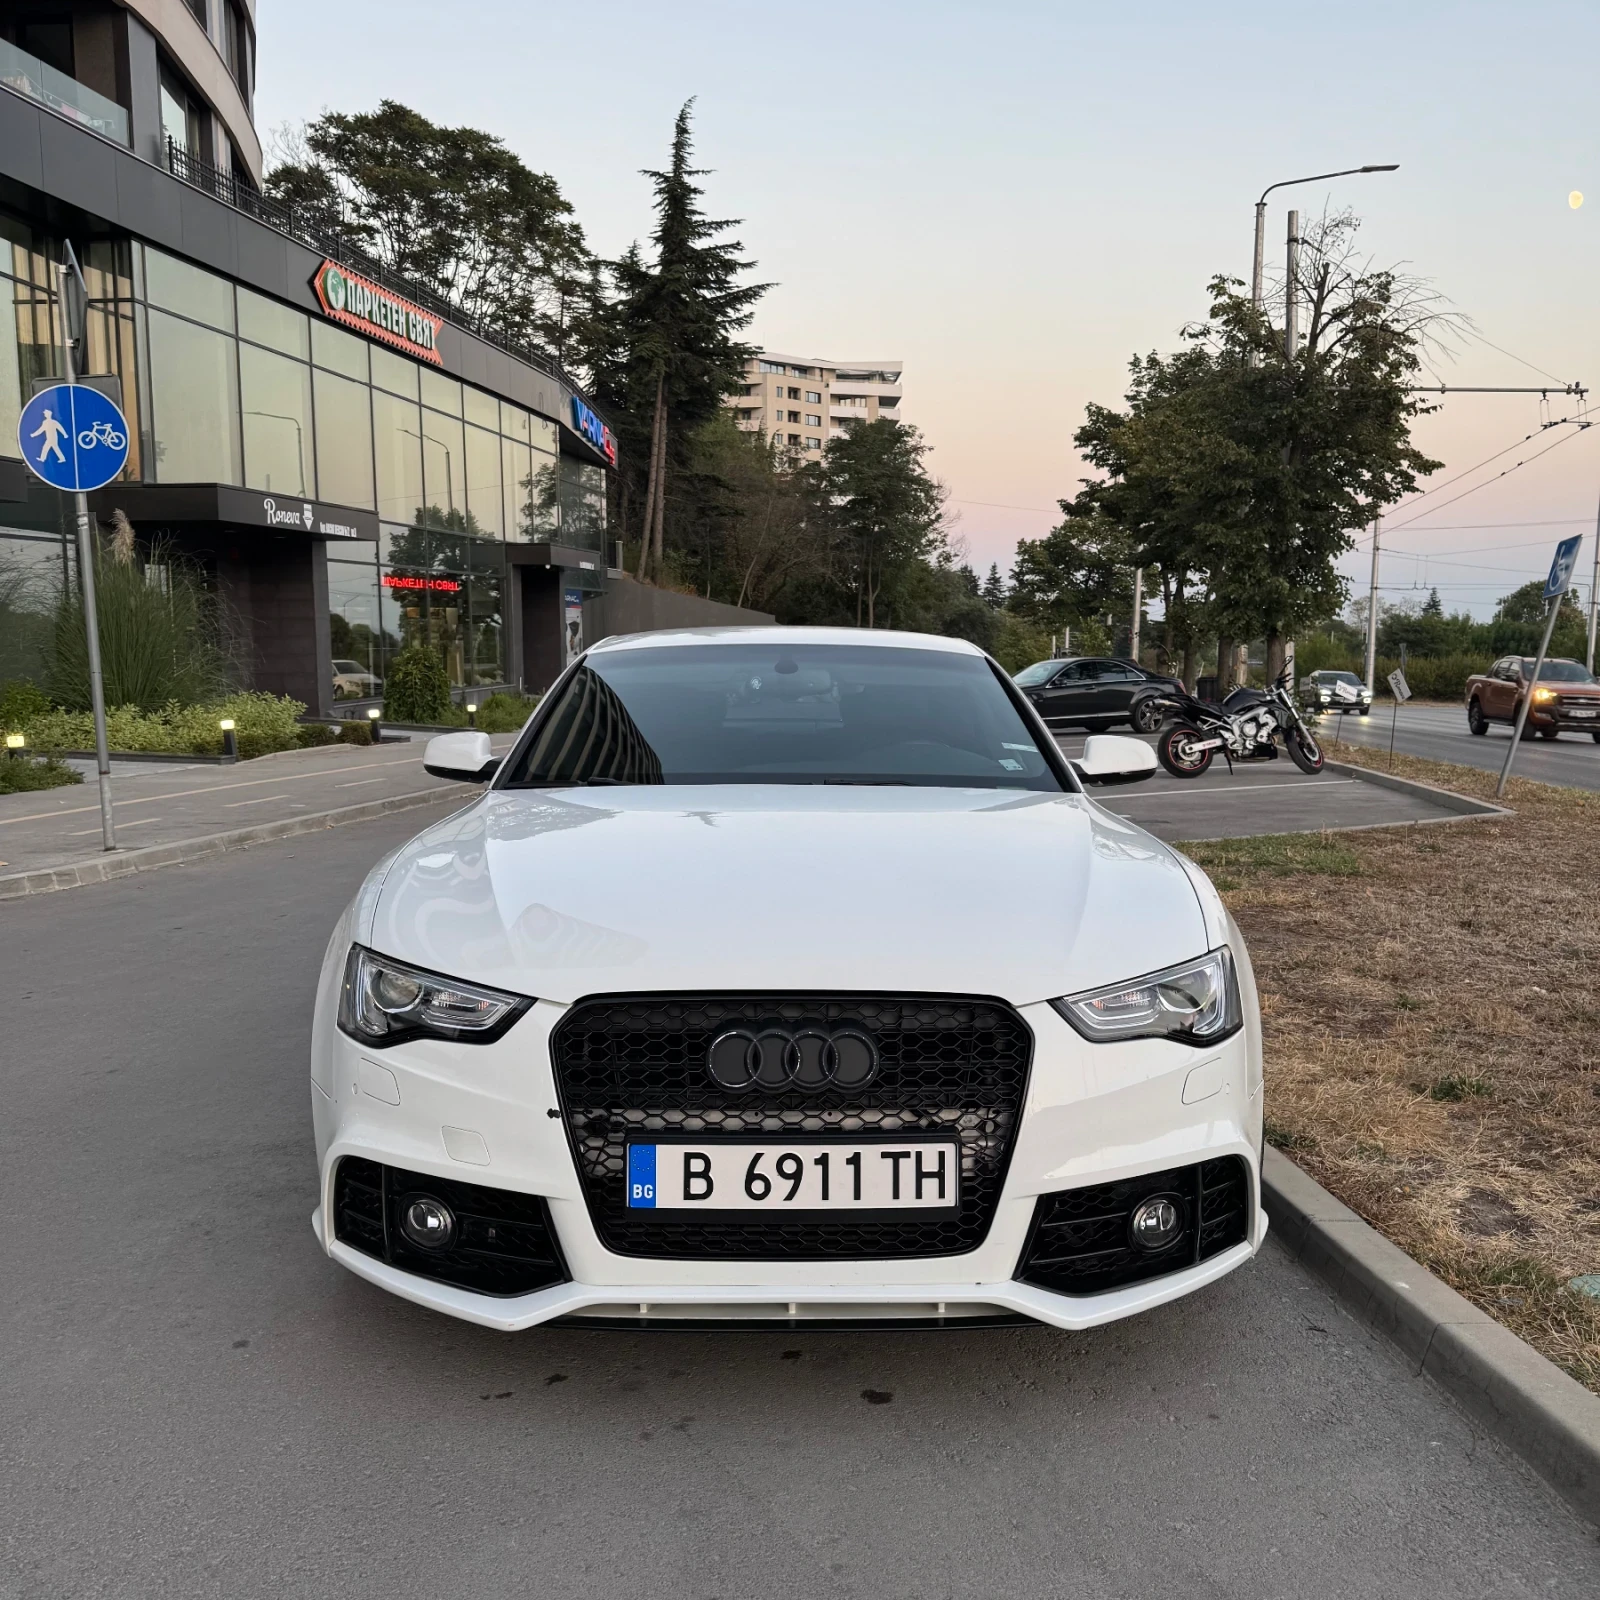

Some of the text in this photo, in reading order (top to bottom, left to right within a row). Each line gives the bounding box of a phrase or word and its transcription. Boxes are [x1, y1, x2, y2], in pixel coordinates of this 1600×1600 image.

[347, 279, 435, 350] ПАРКЕТЕН СВЯТ
[263, 498, 301, 524] Roneva
[632, 1184, 654, 1199] BG
[683, 1150, 946, 1201] B 6911 TH
